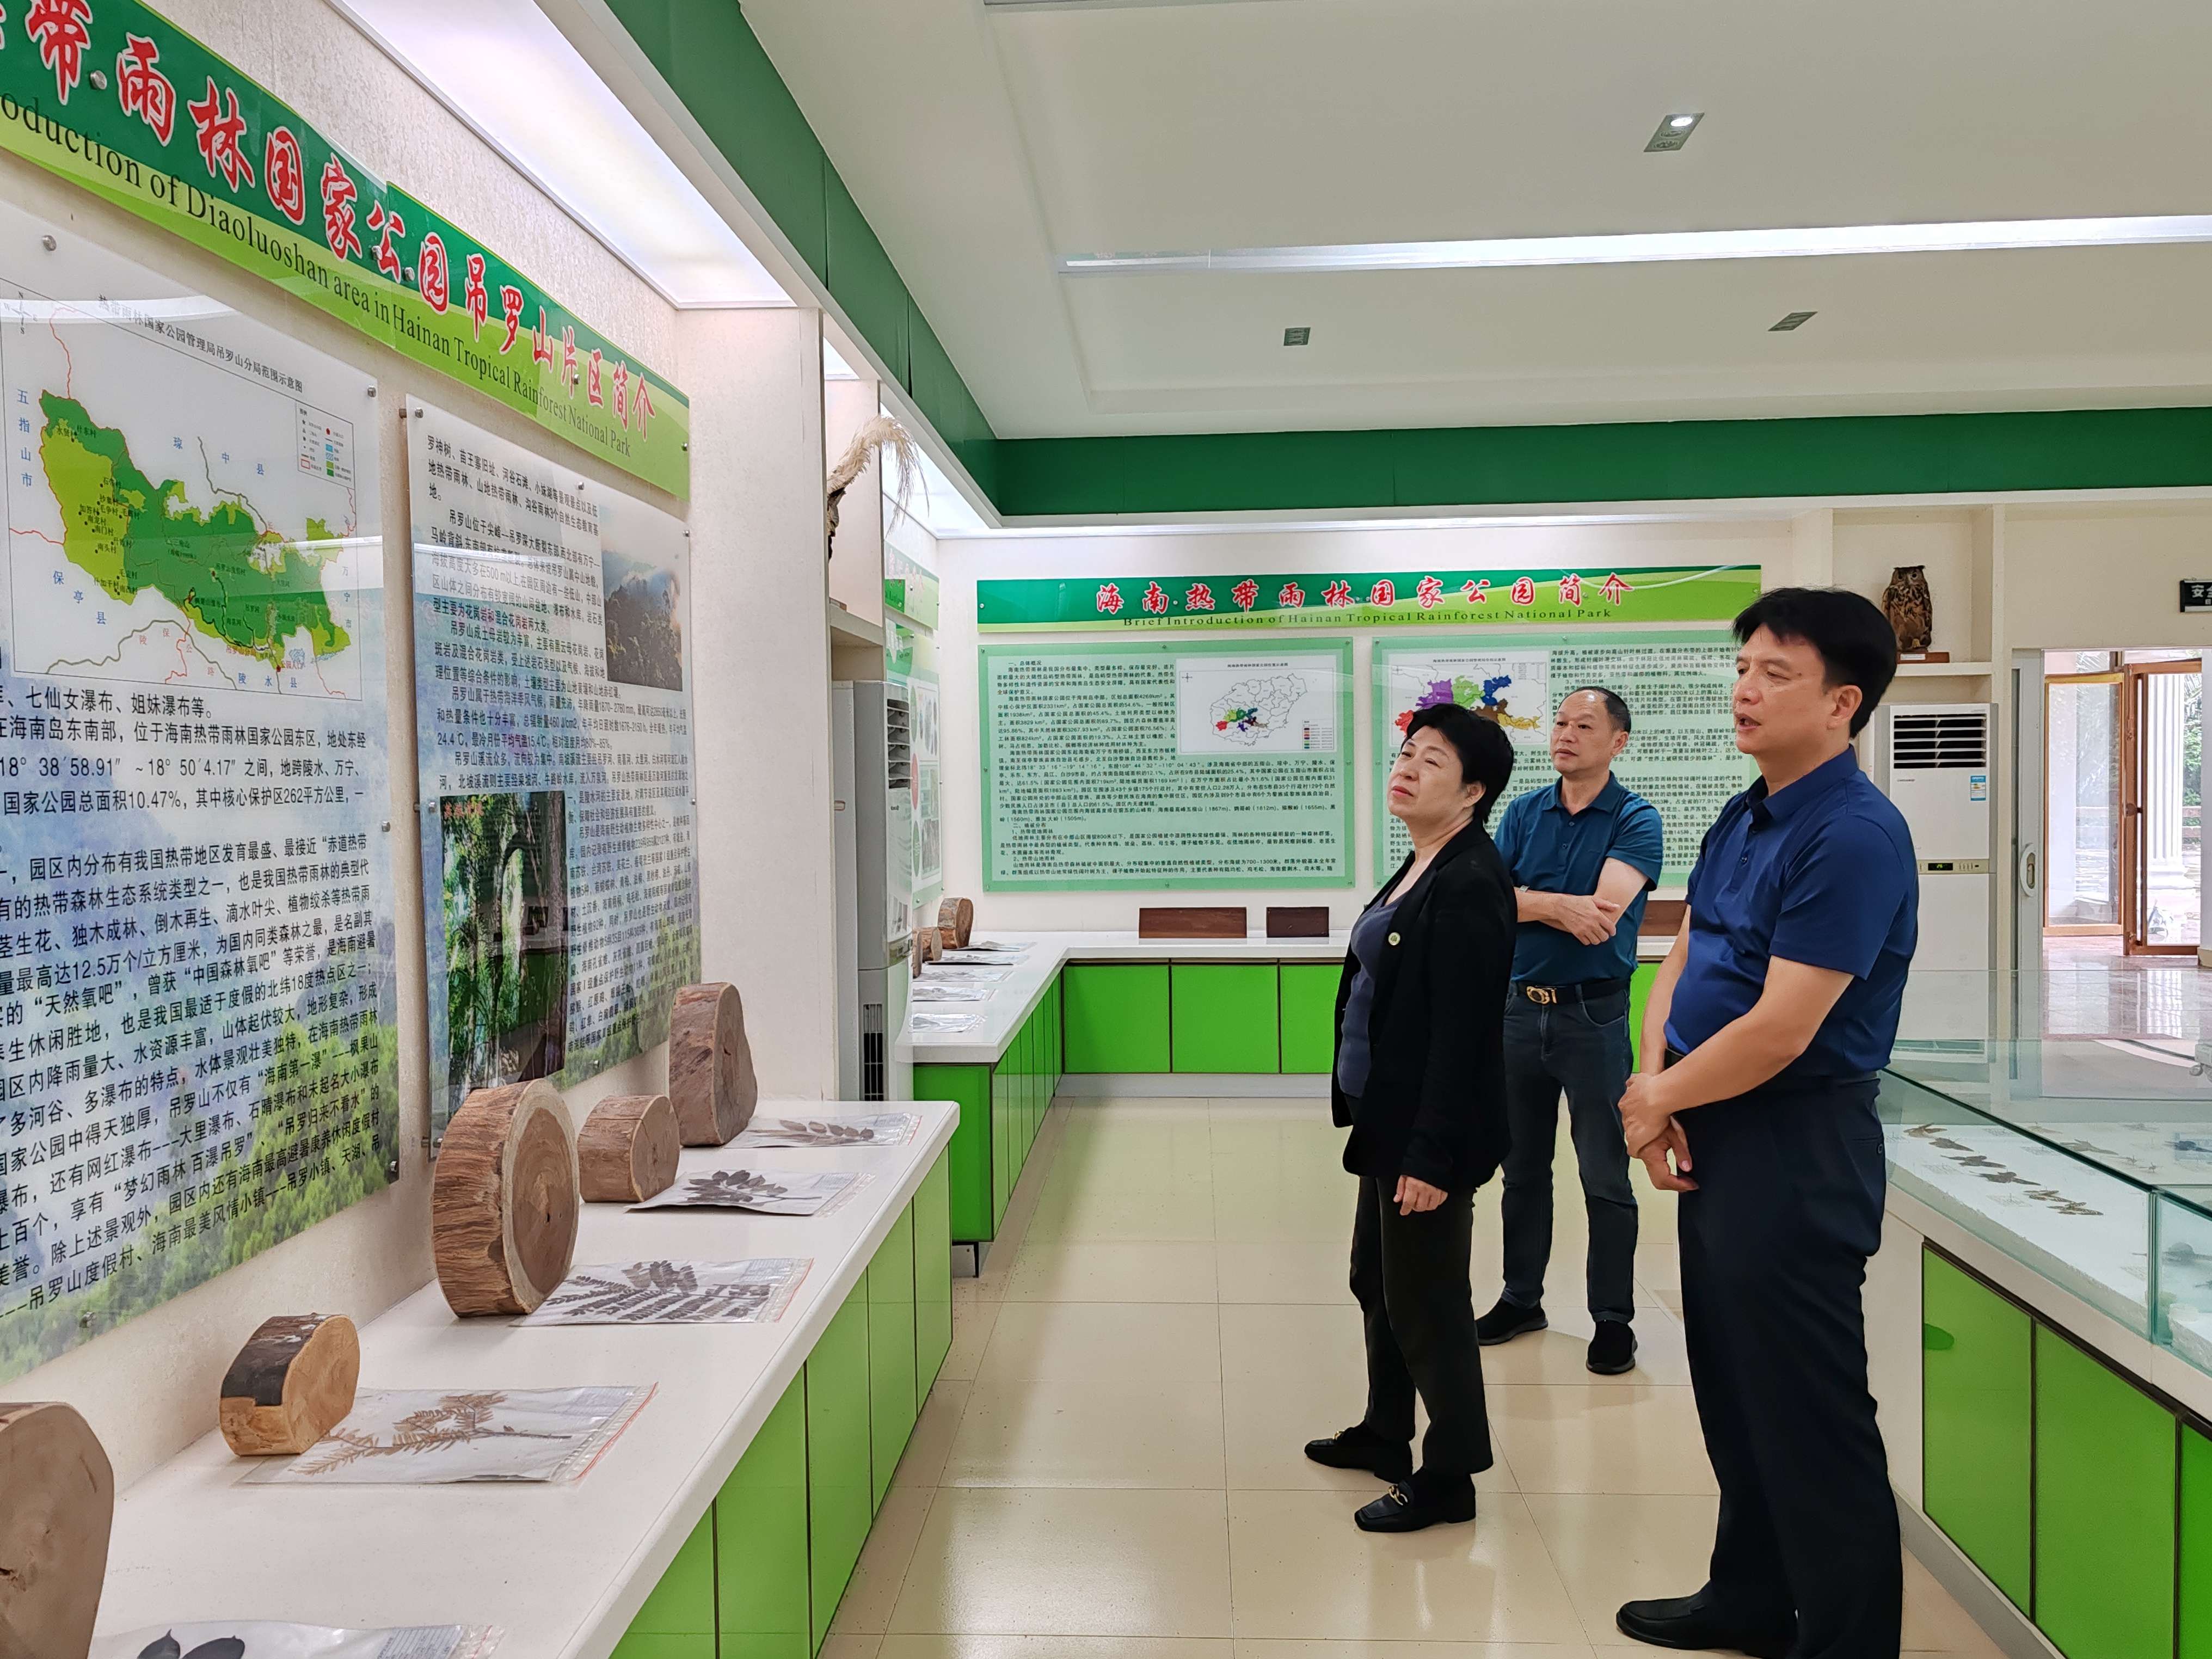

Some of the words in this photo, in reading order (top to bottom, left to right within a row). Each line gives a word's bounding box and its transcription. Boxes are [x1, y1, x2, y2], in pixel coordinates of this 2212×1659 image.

[0, 0, 655, 441] 带雨林国家公园吊罗山片区简介
[150, 170, 181, 207] of
[187, 183, 328, 290] Diaoluoshan
[334, 274, 370, 314] area
[374, 291, 390, 323] in
[392, 302, 450, 358] Hainan
[454, 336, 511, 389] Tropical
[513, 373, 567, 422] Rainforest
[569, 407, 609, 451] National
[610, 425, 631, 458] Park
[16, 389, 33, 488] 五指山市
[429, 482, 442, 502] 地。
[1124, 617, 1163, 626] Brief
[1166, 616, 1263, 626] Introduction
[1269, 614, 1284, 624] of
[1288, 613, 1342, 623] Hainan
[1347, 612, 1411, 623] Tropical
[1416, 611, 1502, 621] Rainforest
[1504, 610, 1571, 619] National
[1577, 609, 1612, 619] Park
[0, 686, 212, 718] 、七仙女瀑布、姐妹瀑布等。
[0, 937, 376, 1028] 的“天然氧吧”，曾获“中国森林氧吧”等荣誉，是海南避暑
